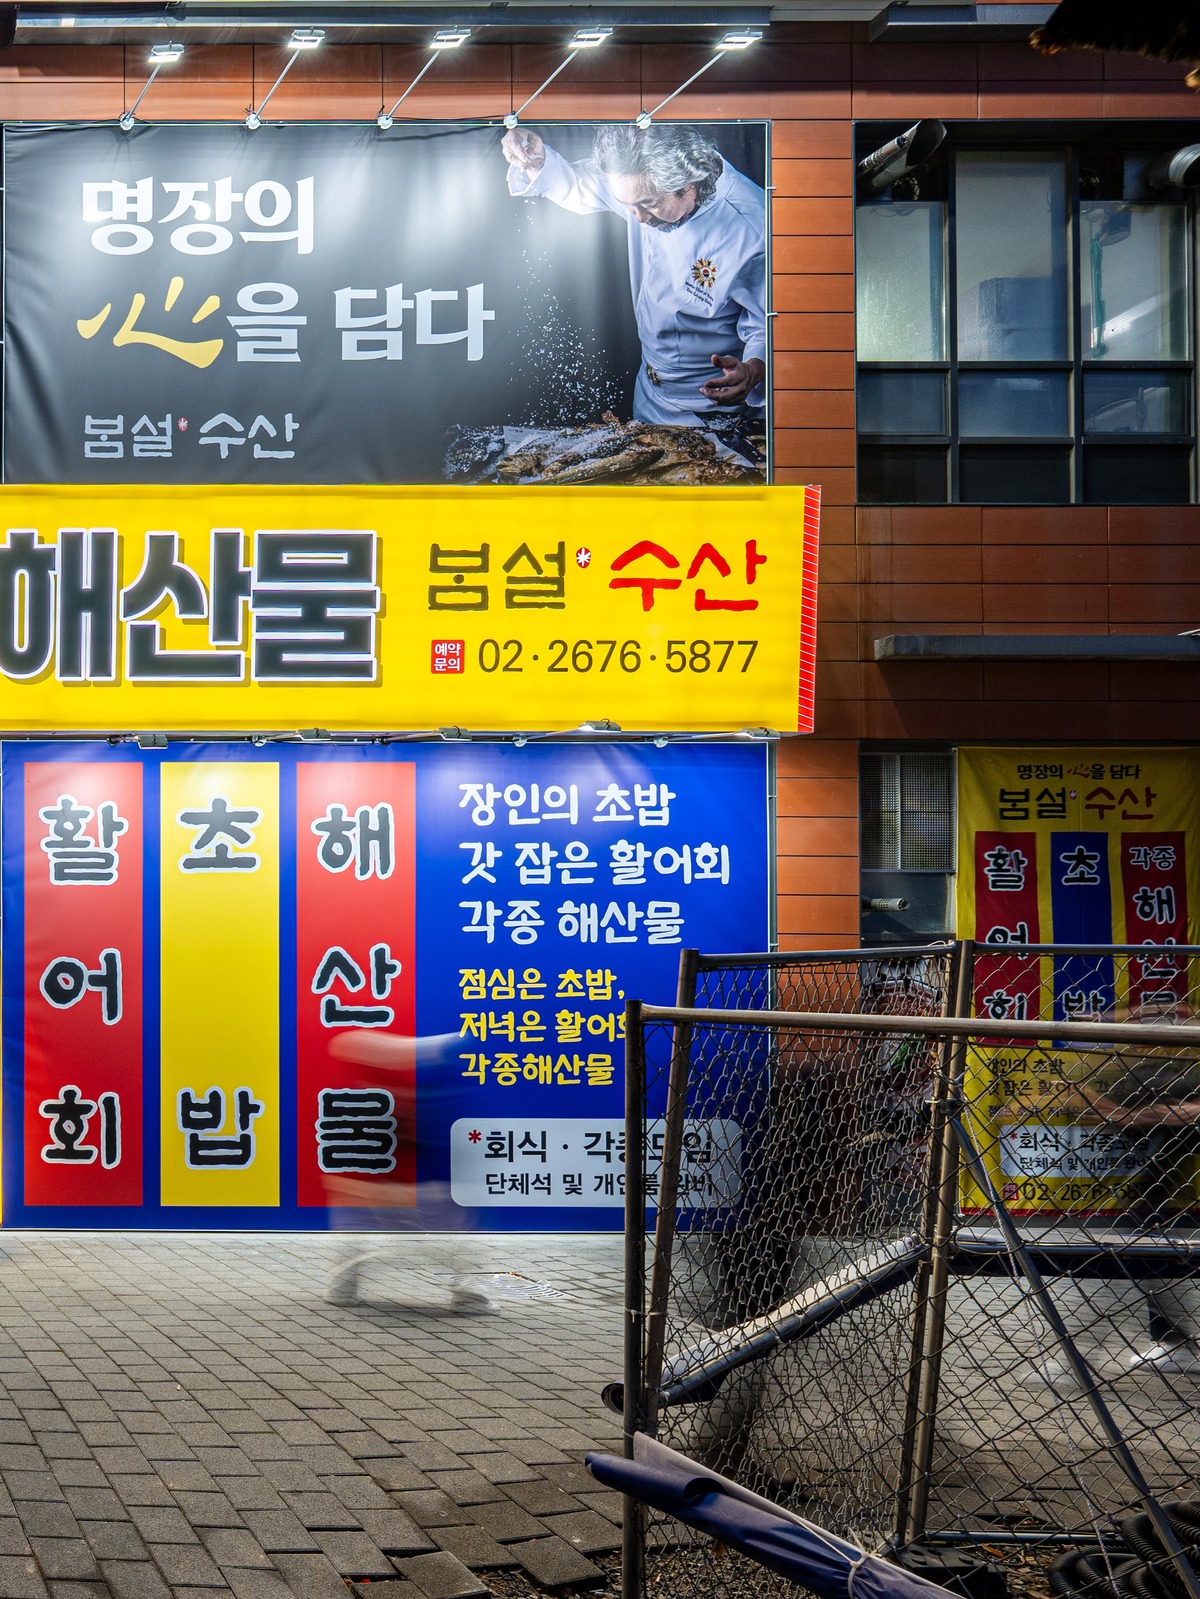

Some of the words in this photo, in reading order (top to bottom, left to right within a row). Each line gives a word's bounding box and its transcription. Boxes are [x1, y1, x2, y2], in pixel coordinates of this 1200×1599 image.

[82, 176, 314, 255] 명장의
[333, 282, 495, 361] 담다
[84, 413, 173, 459] 봄설
[199, 412, 299, 459] 수산
[428, 541, 565, 611] 봄설
[609, 539, 767, 612] 수산
[433, 657, 461, 671] 문의
[434, 642, 461, 656] 예약
[1017, 764, 1063, 780] 명장의
[1110, 764, 1141, 780] 담다
[459, 783, 578, 826] 장인의
[592, 783, 676, 827] 초밥
[999, 787, 1067, 821] 봄설
[1084, 786, 1157, 820] 수산
[459, 841, 502, 885] 갓
[514, 841, 598, 885] 잡은
[609, 839, 730, 886] 활어회
[1130, 846, 1176, 871] 각종
[458, 900, 545, 945] 각종
[557, 900, 685, 945] 해산물
[38, 793, 129, 1170] 활어회
[175, 793, 265, 1171] 초밥
[311, 801, 402, 1175] 해산물
[458, 967, 547, 1001] 점심은
[555, 968, 625, 1001] 초밥,
[459, 1009, 546, 1043] 저녁은
[459, 1052, 615, 1086] 각종해산물
[988, 1058, 1026, 1074] 장인의
[485, 1172, 552, 1196] 단체석
[562, 1172, 583, 1196] 및
